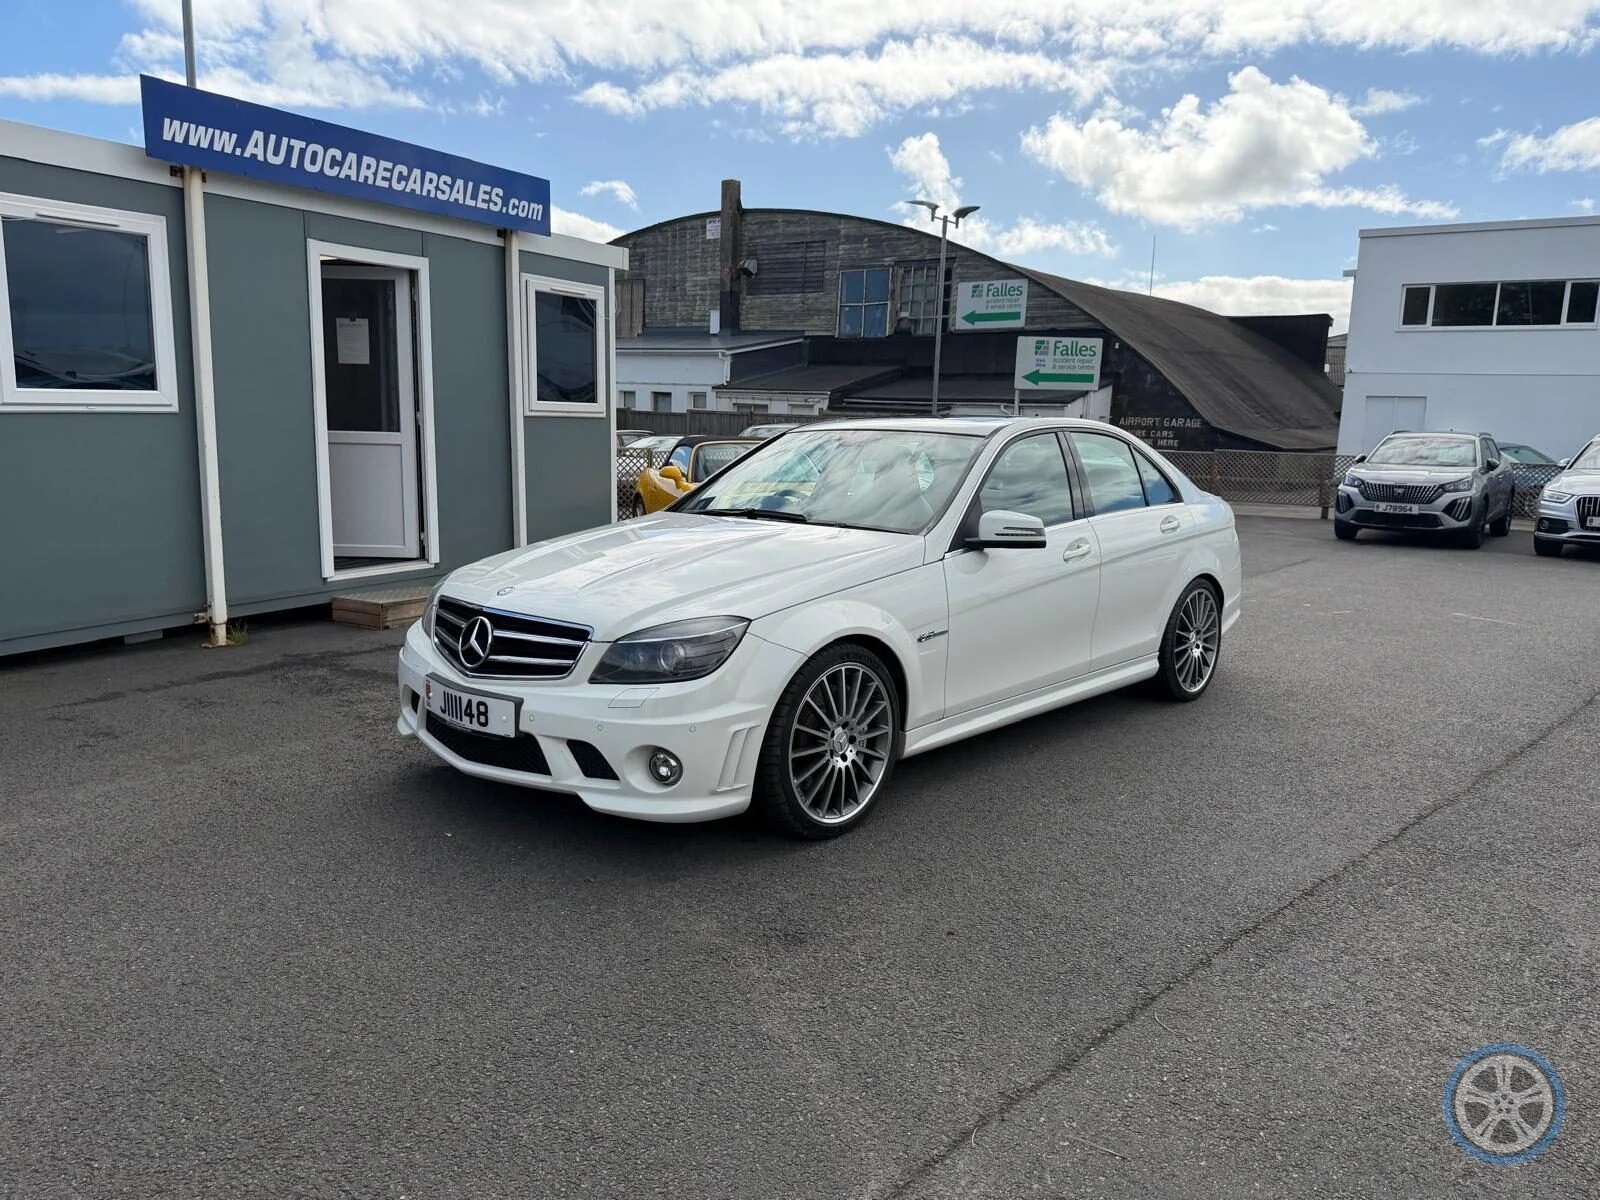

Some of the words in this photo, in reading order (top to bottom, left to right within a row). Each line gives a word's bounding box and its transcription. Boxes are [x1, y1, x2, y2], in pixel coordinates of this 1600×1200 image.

[162, 117, 542, 222] www.AUTOCARECARSALES.com
[986, 283, 1023, 298] Falles
[1053, 340, 1097, 357] Falles
[1119, 417, 1160, 426] AIRPORT
[1164, 418, 1202, 428] GARAGE
[1150, 430, 1174, 438] CARS
[1157, 438, 1180, 447] HERE
[440, 690, 489, 728] J111148
